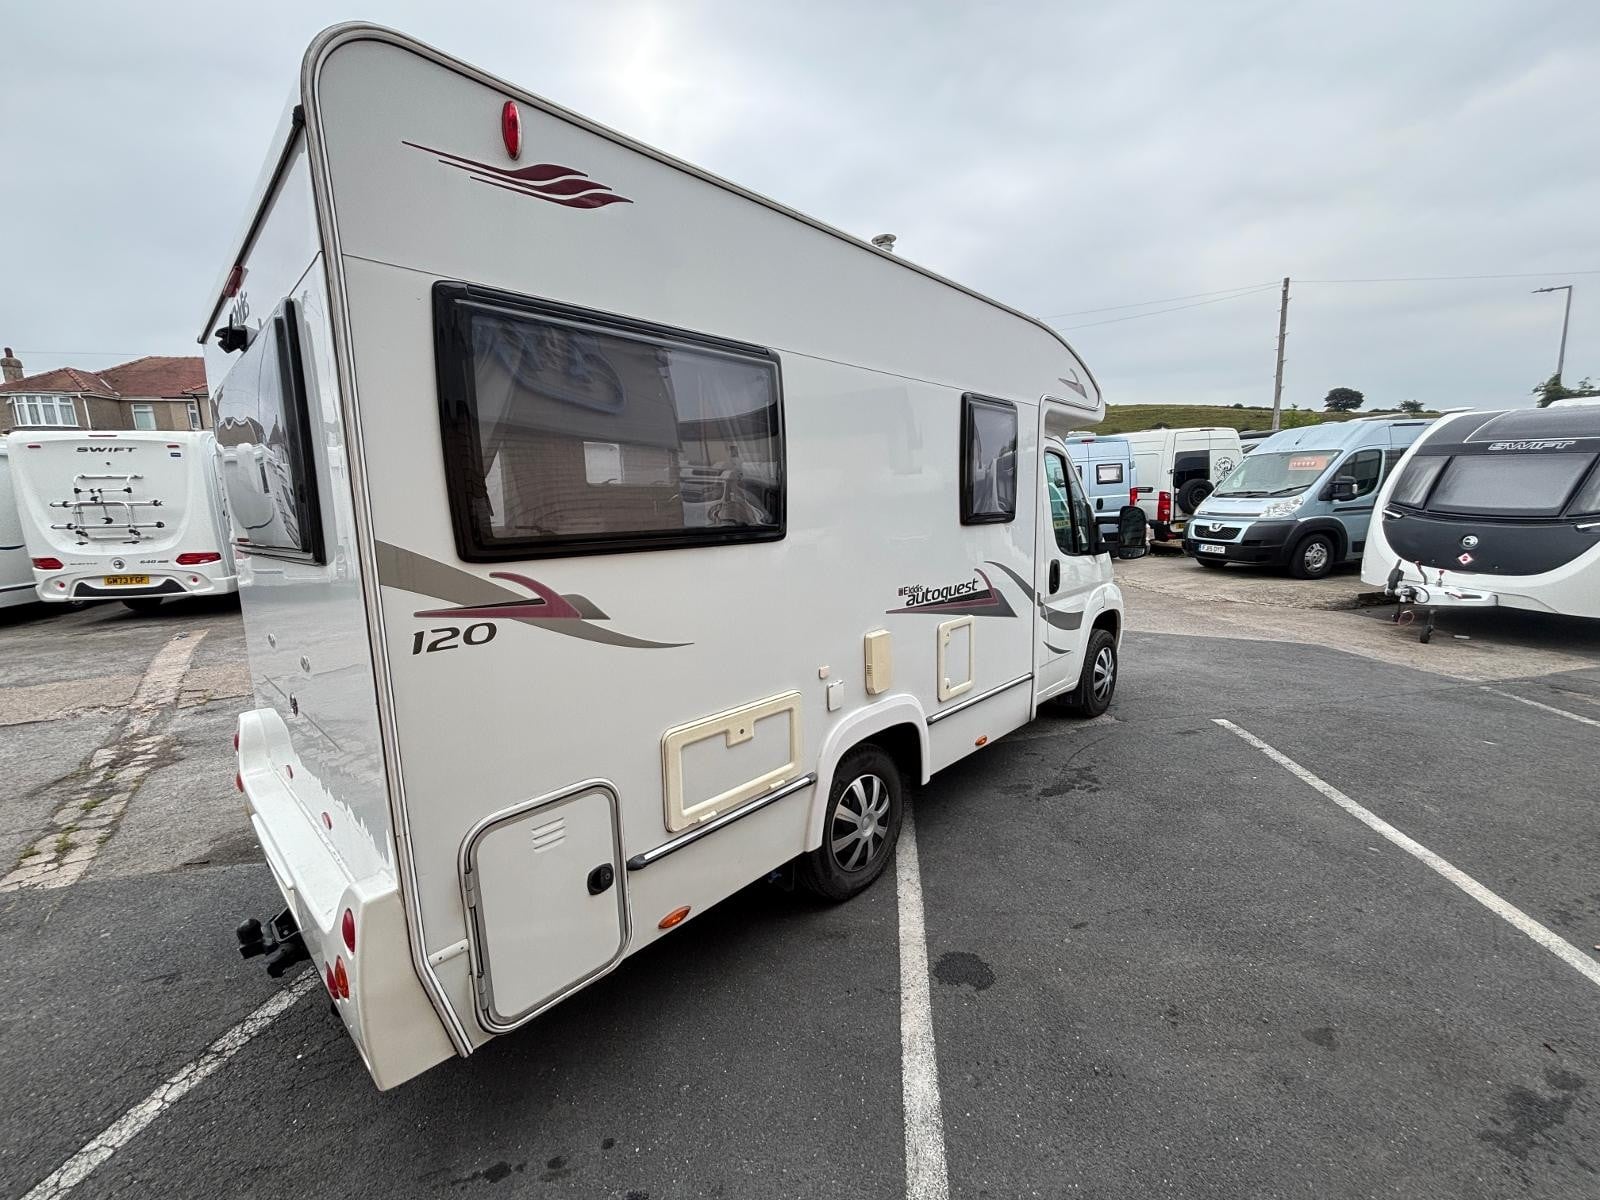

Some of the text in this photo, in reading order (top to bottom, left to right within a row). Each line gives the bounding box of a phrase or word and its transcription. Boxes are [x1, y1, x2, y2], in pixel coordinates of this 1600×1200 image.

[1488, 440, 1577, 451] SWIFT
[906, 578, 979, 606] autoquest
[412, 622, 497, 655] 120
